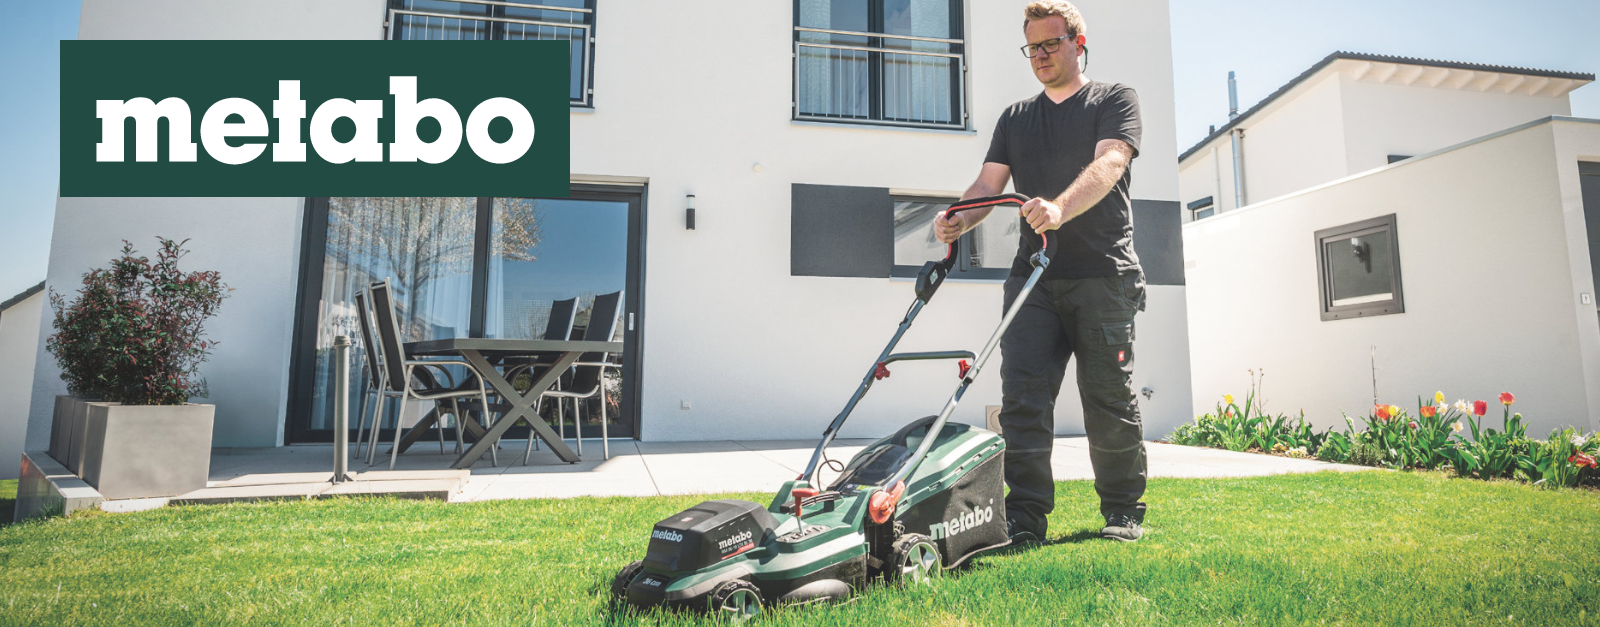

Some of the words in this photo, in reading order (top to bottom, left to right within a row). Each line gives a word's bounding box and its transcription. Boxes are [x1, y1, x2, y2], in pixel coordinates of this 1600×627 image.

[929, 506, 993, 540] metabo
[652, 529, 683, 543] metabo
[719, 530, 752, 549] metabo
